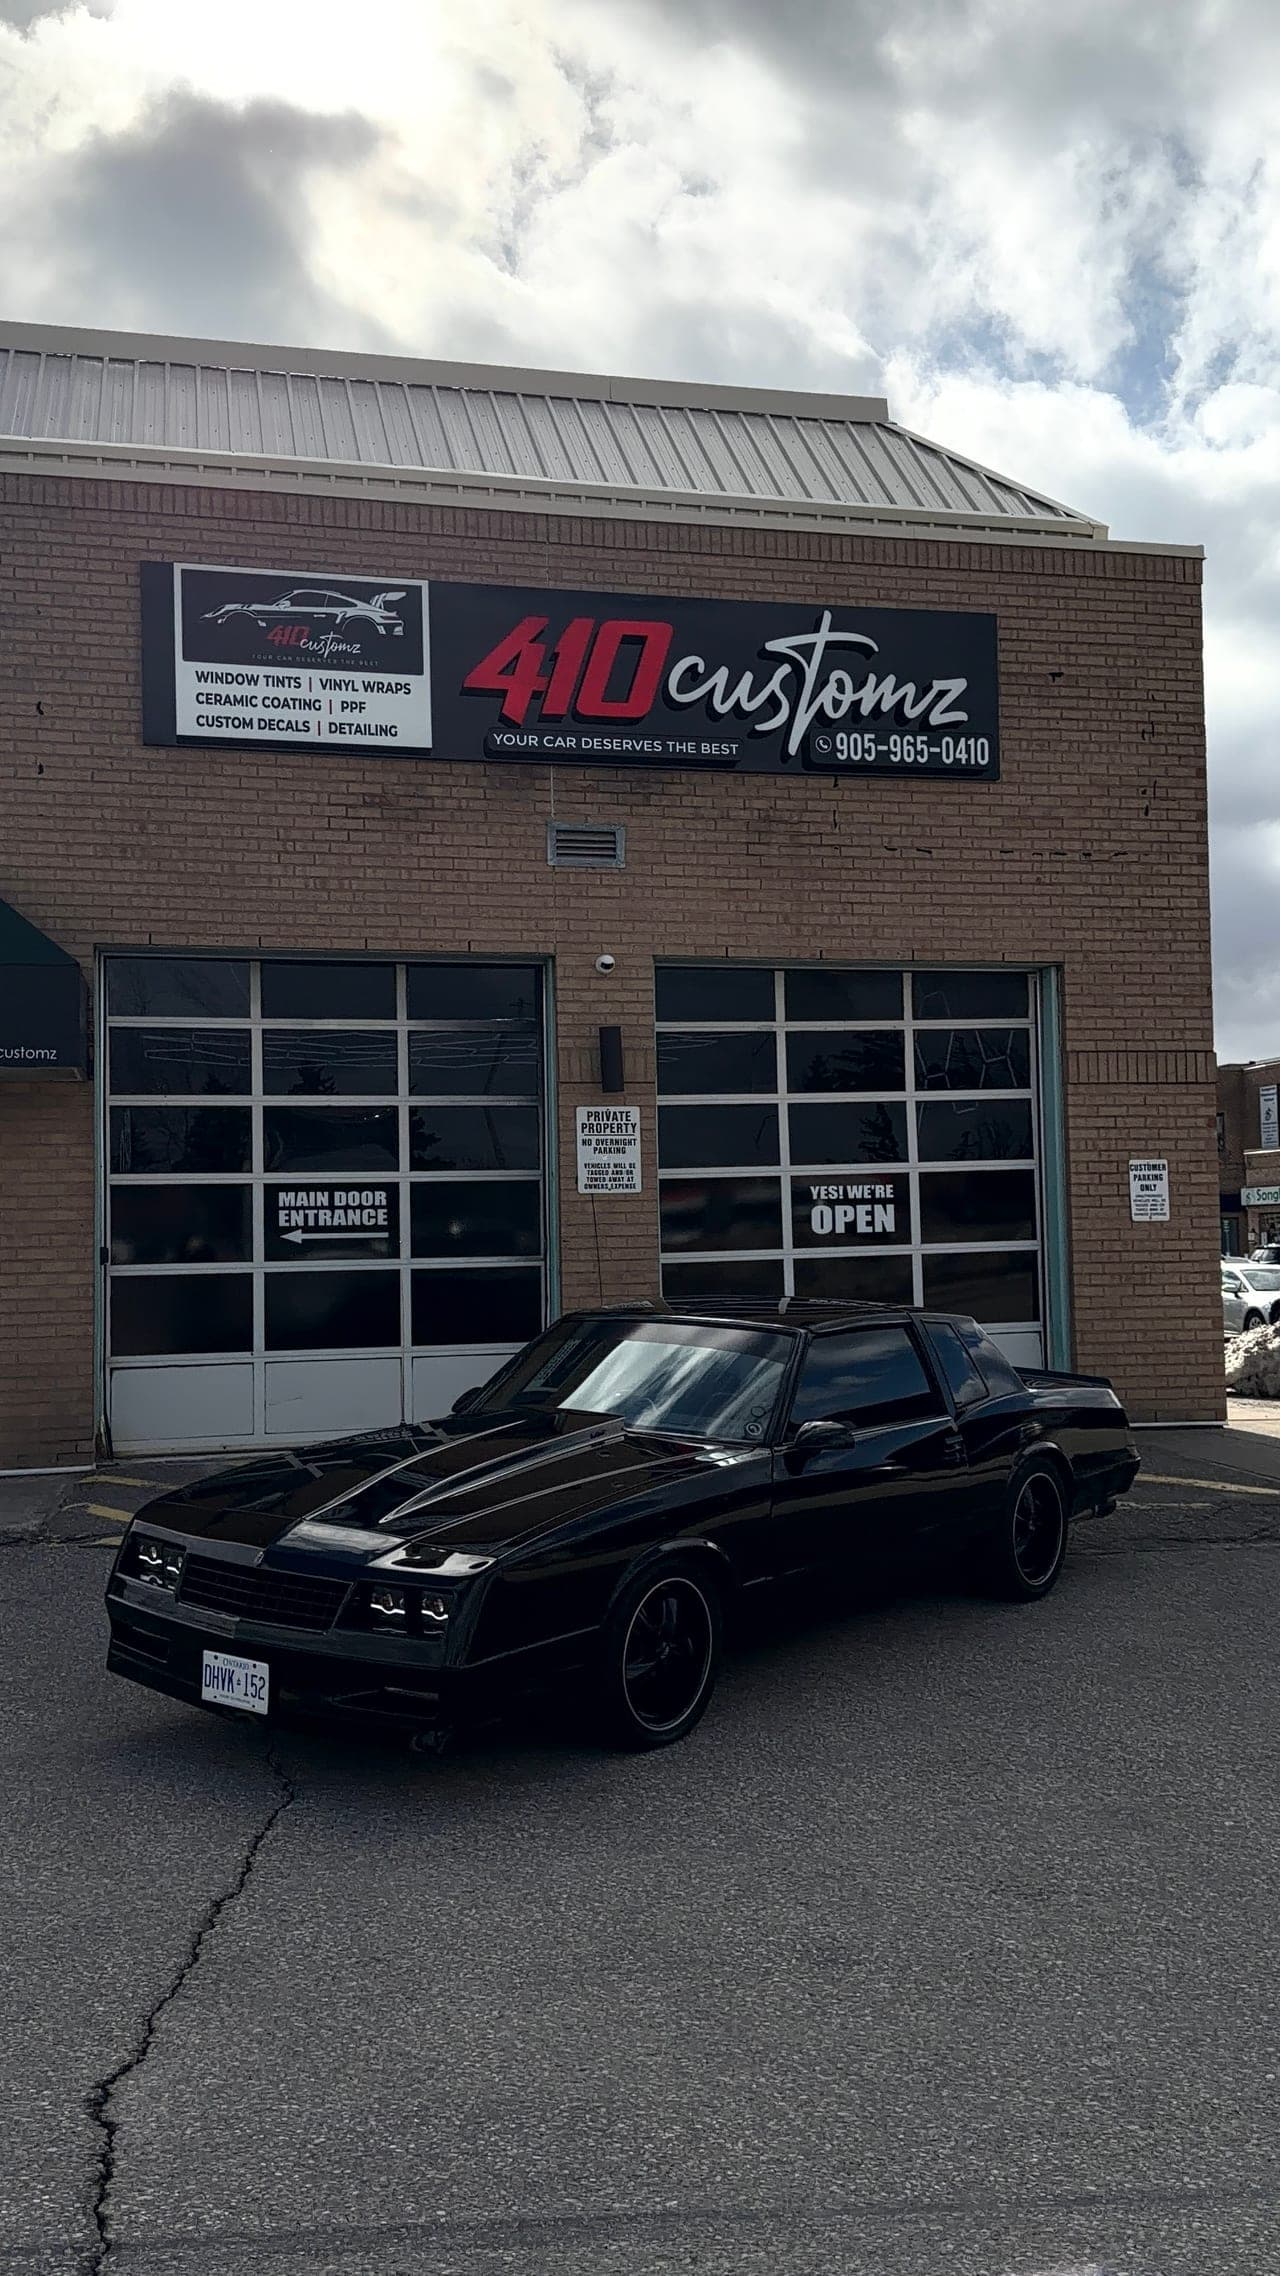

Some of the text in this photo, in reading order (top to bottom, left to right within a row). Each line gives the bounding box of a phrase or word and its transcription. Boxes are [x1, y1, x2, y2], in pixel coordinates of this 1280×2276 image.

[266, 625, 361, 658] 410 customz
[195, 670, 412, 695] WINDOW TINTS VINYL WRAPS
[462, 609, 969, 756] 410 customz
[195, 692, 367, 714] CERAMIC COATING PPF
[196, 715, 398, 737] CUSTOM DECALS DETAILING
[493, 733, 739, 755] YOUR CAR DESERVES THE BEST
[835, 731, 990, 766] 905-965-0410
[587, 1111, 631, 1122] PRIVATE
[581, 1123, 637, 1134] PROPERTY
[595, 1138, 637, 1146] OVERNIGHT
[278, 1190, 387, 1208] MAIN DOOR
[809, 1184, 894, 1200] YES! WE'RE
[1140, 1184, 1157, 1192] ONLY
[1256, 1187, 1280, 1203] Song
[278, 1208, 388, 1227] ENTRANCE
[811, 1204, 895, 1235] OPEN
[204, 1663, 266, 1701] DHVK 152
